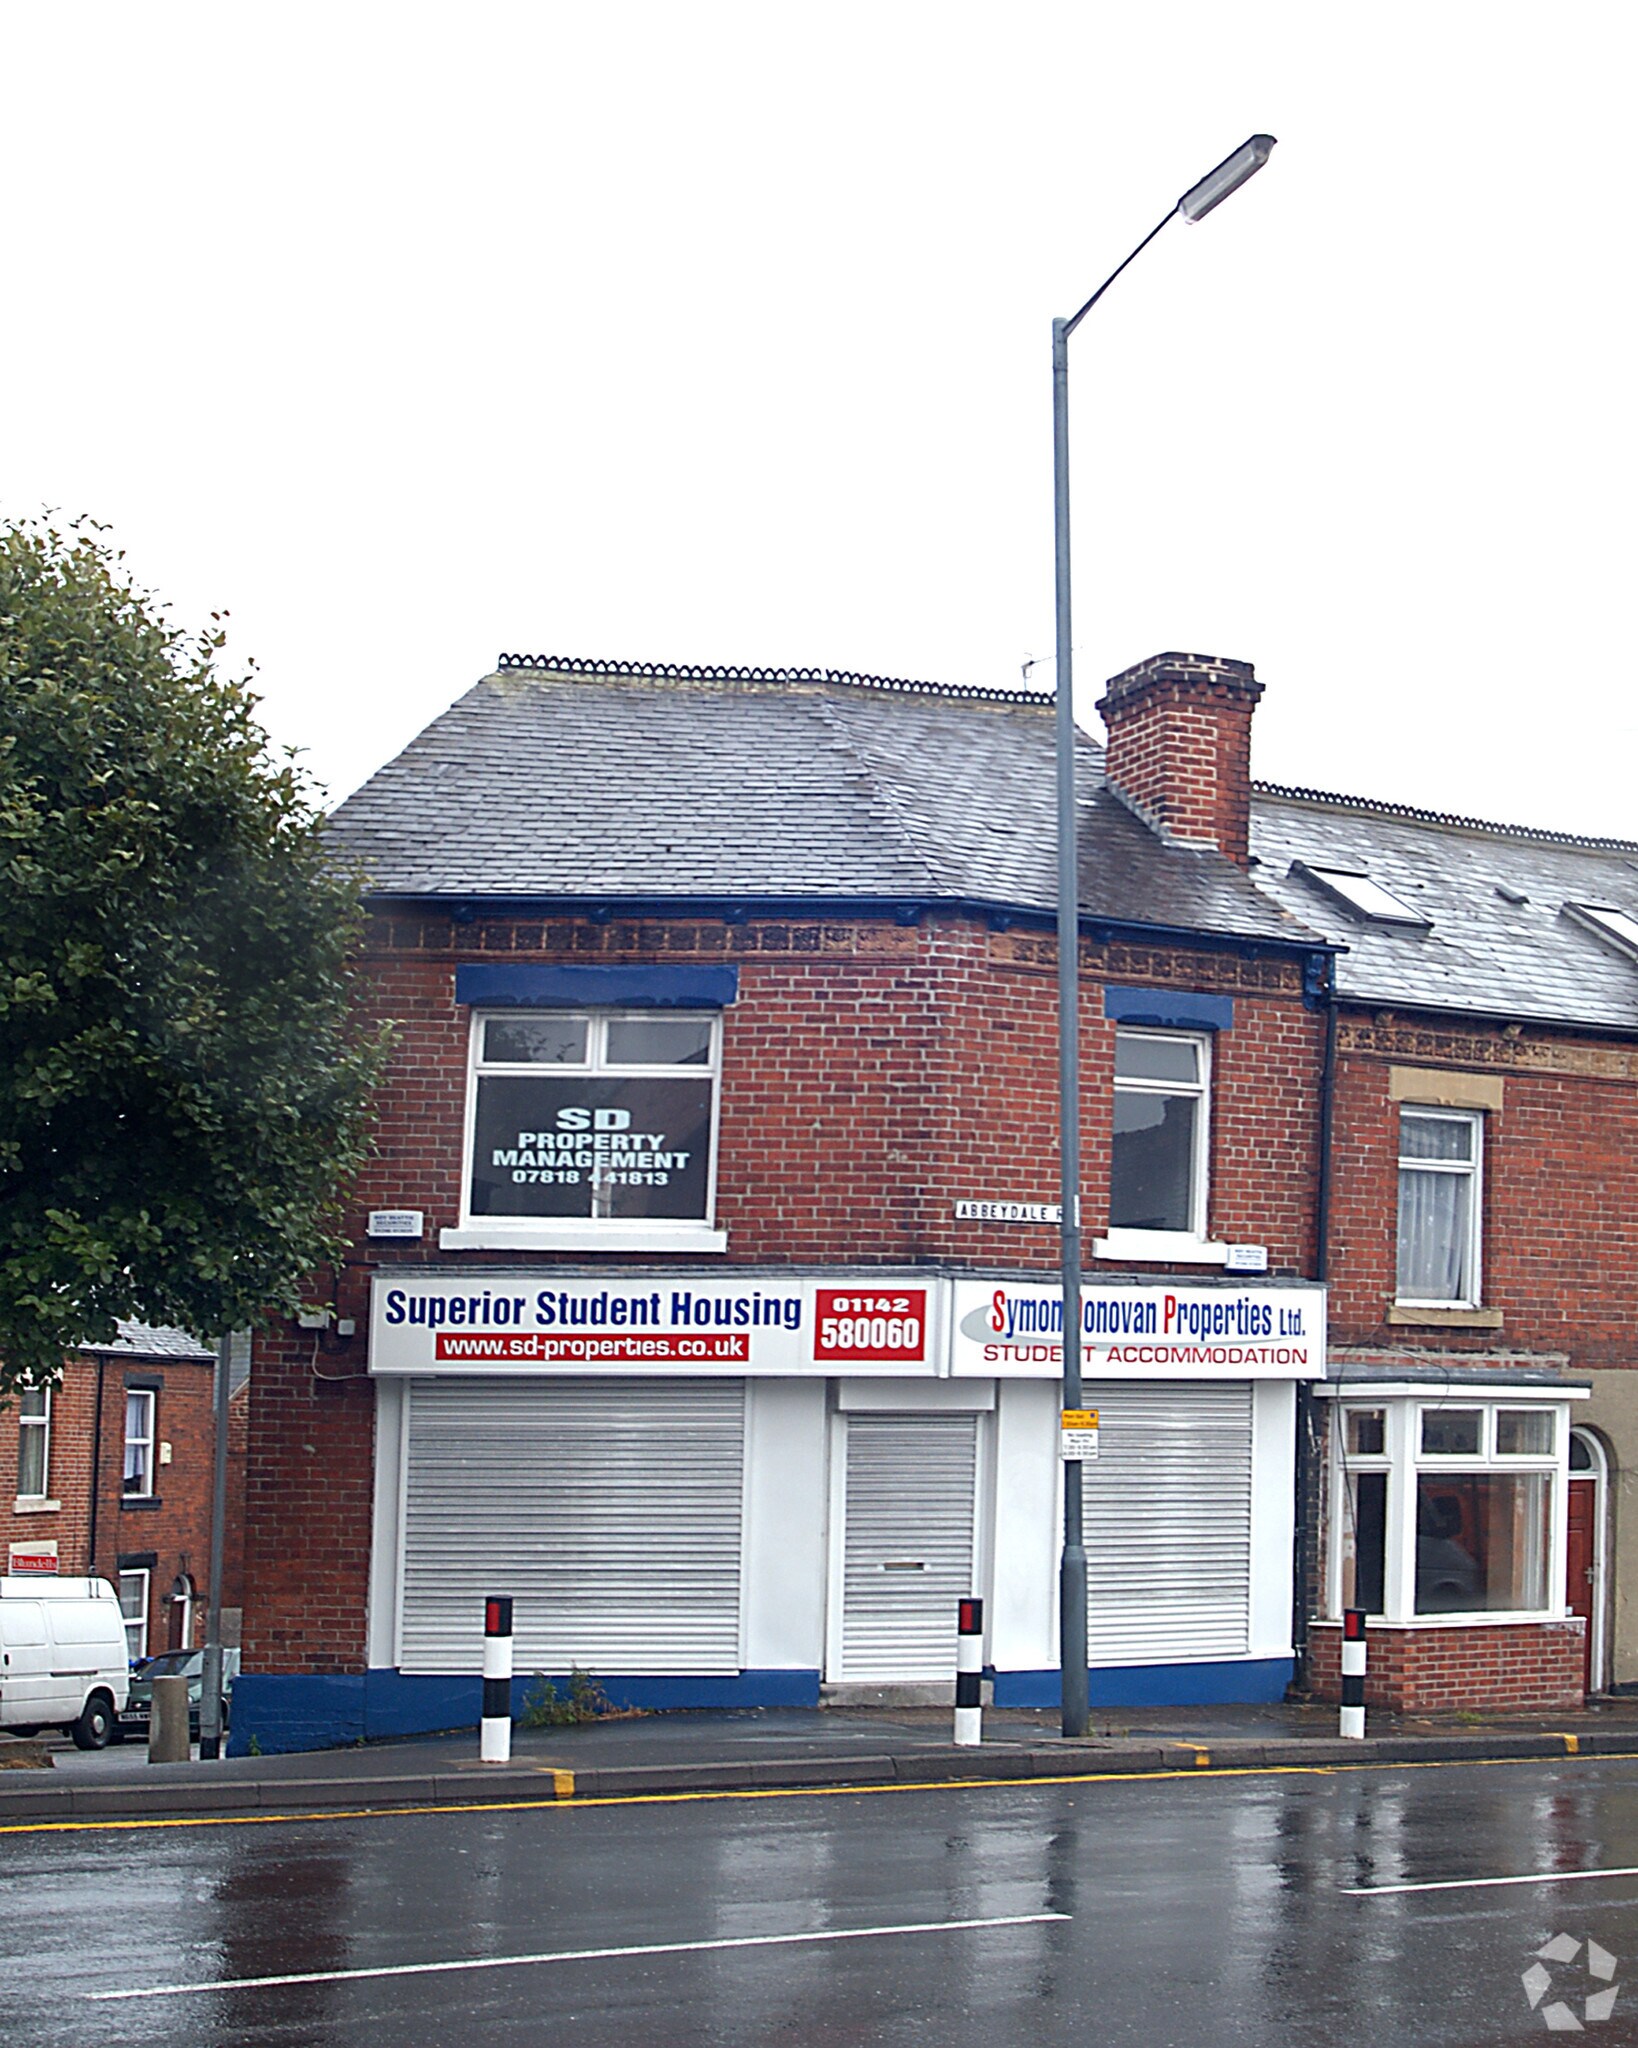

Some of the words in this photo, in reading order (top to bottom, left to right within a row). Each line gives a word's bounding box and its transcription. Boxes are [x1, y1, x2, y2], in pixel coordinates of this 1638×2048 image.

[555, 1107, 631, 1131] SD
[517, 1132, 666, 1151] PROPERTY
[492, 1149, 690, 1169] MANAGEMENT
[511, 1169, 580, 1184] 07818
[587, 1170, 669, 1186] 441813
[960, 1203, 1048, 1220] ABBEYDALE
[385, 1290, 527, 1329] Superior
[534, 1291, 661, 1326] Student
[671, 1292, 802, 1330] Housing
[831, 1296, 909, 1313] 01142
[991, 1290, 1063, 1339] Symon
[1079, 1293, 1157, 1335] onovan
[1163, 1294, 1272, 1342] Properties
[1279, 1308, 1306, 1336] Ltd.
[820, 1317, 920, 1350] 580060
[442, 1335, 744, 1359] www.sd-properties.co.uk
[983, 1344, 1096, 1363] STUDET
[1106, 1346, 1308, 1365] ACCOMMODATION
